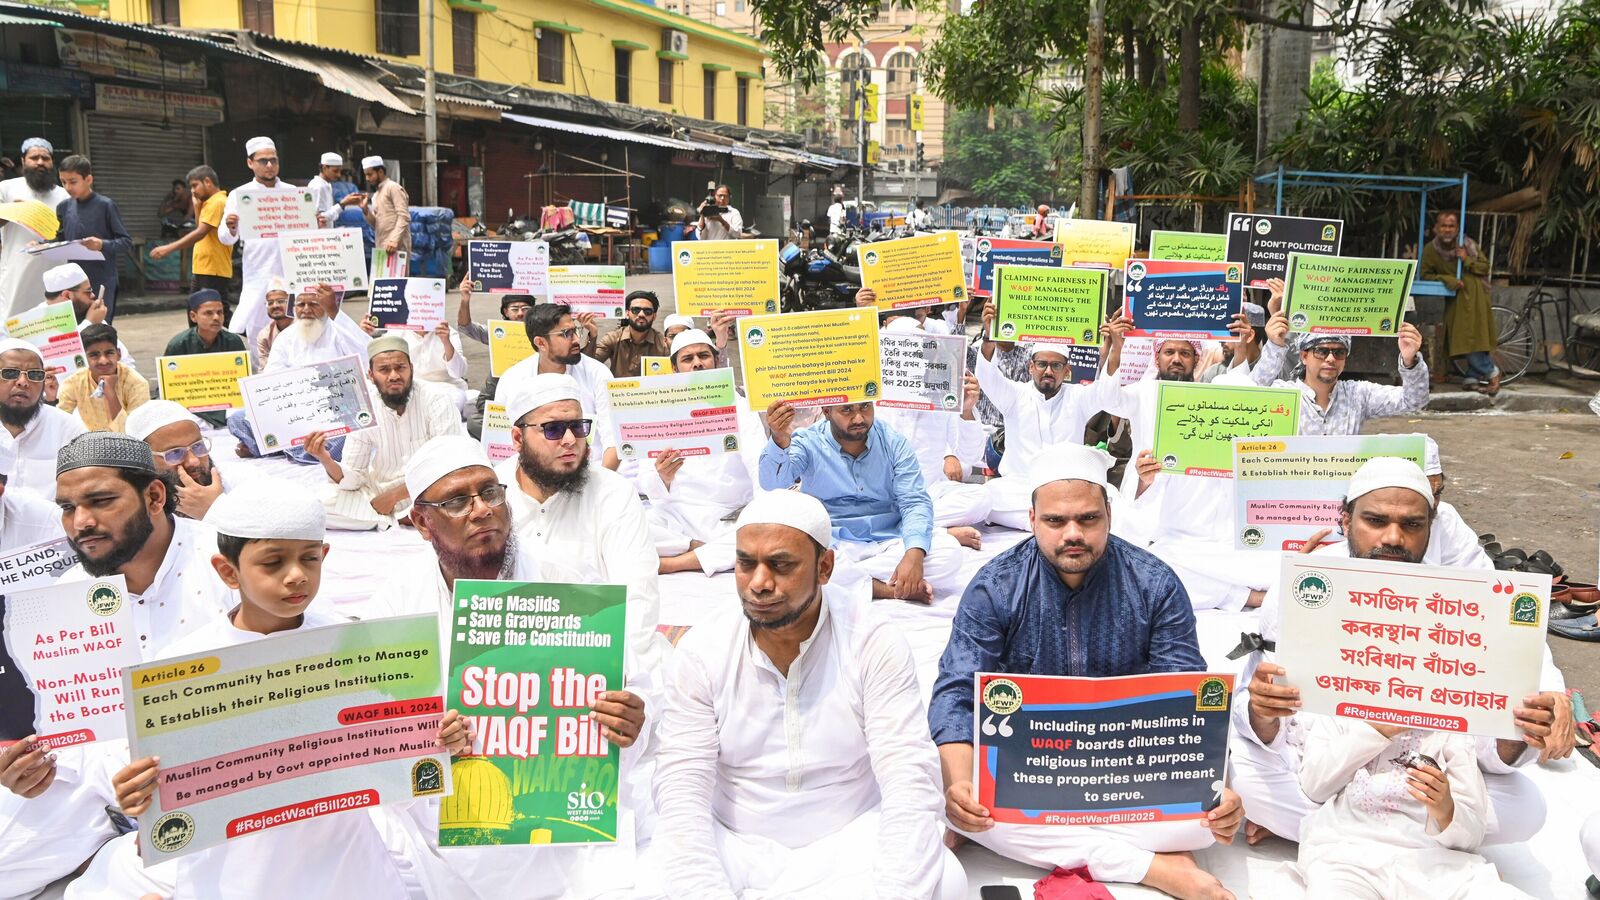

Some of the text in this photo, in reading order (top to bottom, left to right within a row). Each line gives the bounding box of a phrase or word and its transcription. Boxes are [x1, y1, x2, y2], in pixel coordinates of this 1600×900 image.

[1261, 240, 1333, 252] DON'T POLITICIZE
[1252, 251, 1286, 260] SACRED
[1251, 263, 1284, 271] ASSETS!
[1299, 263, 1403, 275] CLAIMING FAIRNESS IN
[1306, 274, 1331, 282] WAQF
[1011, 284, 1090, 294] WAQF MANAGEMENT
[1303, 284, 1329, 292] WHILE
[1332, 286, 1374, 294] IGNORING
[1008, 313, 1053, 321] RESISTANCE
[1299, 304, 1351, 312] RESISTANCE
[1025, 324, 1069, 332] HYPOCRISY.
[1264, 456, 1310, 464] Community
[17, 549, 60, 567] LAND,
[471, 595, 560, 612] Save Masjids
[1348, 588, 1485, 621] মসজিদ বাঁচাও,
[470, 612, 581, 630] Save Graveyards
[35, 622, 115, 645] As Per Bill
[468, 629, 611, 647] Save the Constitution
[1341, 619, 1487, 650] কবরস্থান বাঁচাও,
[33, 638, 123, 660] Muslim WAQF
[1340, 645, 1415, 671] সংবিধান
[37, 669, 123, 691] Non-Musli
[141, 663, 205, 684] Article 26
[143, 648, 429, 706] Each Community has Freedom to Manage
[55, 687, 120, 704] Will Run
[462, 666, 606, 713] Stop the
[1388, 677, 1424, 701] বিল
[1430, 687, 1508, 711] প্রত্যাহার
[146, 672, 414, 729] & Establish their Religious Institutions.
[49, 709, 75, 723] the
[344, 702, 438, 722] WAQF BILL 2024
[1344, 706, 1459, 729] #RejectWaqfBill2025
[1030, 715, 1205, 735] Including non-Muslims in
[556, 715, 609, 757] Bill
[1031, 734, 1201, 750] WAQF boards dilutes the
[166, 720, 439, 784] Muslim Community Religious Institutions Will
[1026, 752, 1204, 769] religious intent & purpose
[176, 741, 435, 800] Be managed by Govt appointed Non Musli
[1013, 768, 1214, 786] these properties were meant
[1084, 790, 1144, 802] to serve.
[235, 794, 370, 833] #RejectWaqfBill2025
[1045, 812, 1155, 824] #RejectWaqfBill2025
